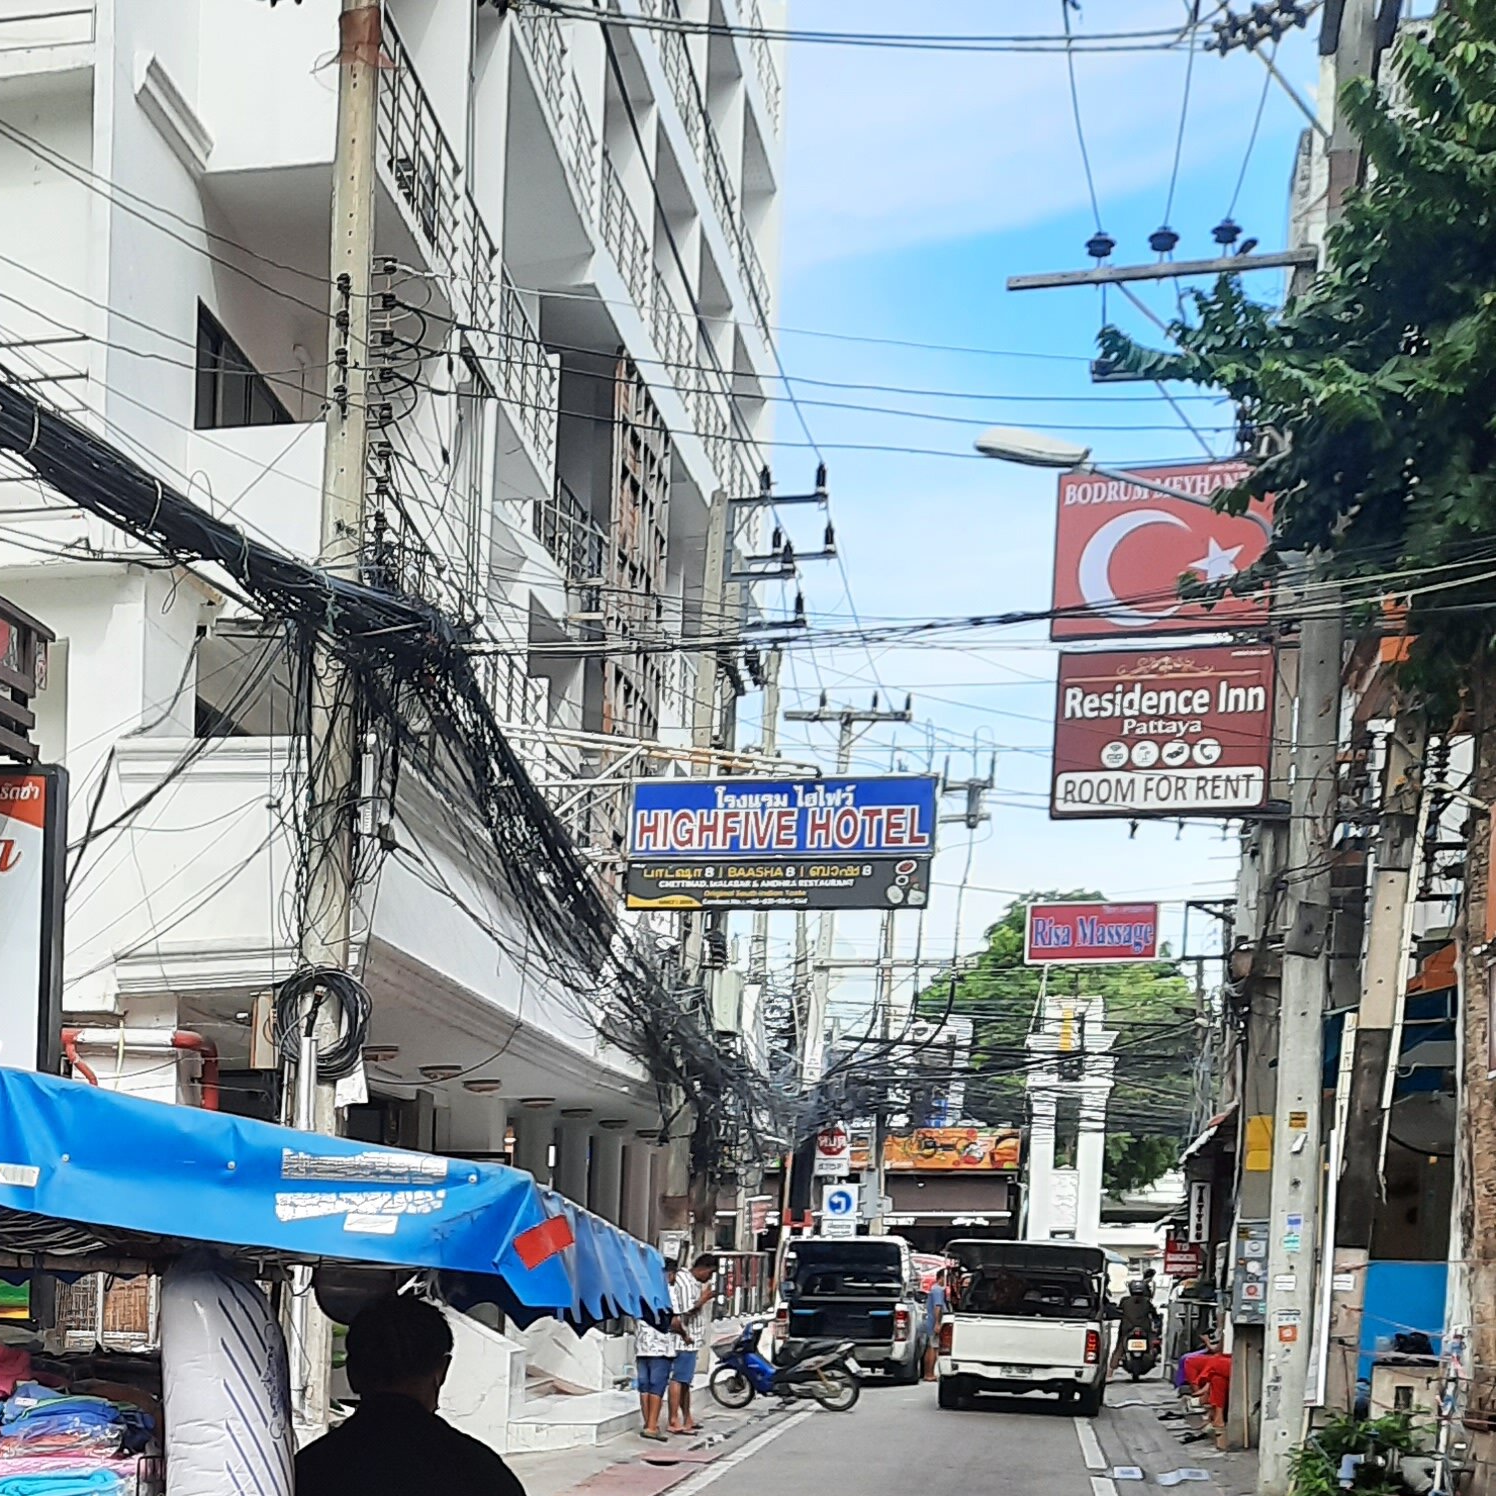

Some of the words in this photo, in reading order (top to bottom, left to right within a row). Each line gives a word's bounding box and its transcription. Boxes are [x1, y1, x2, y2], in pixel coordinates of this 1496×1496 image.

[1064, 480, 1152, 505] BODRUM
[1064, 682, 1210, 719] Residence
[1217, 680, 1266, 713] Inn
[1121, 717, 1202, 737] Pattaya
[714, 785, 788, 809] โรงแรม
[1063, 777, 1136, 804] ROOM
[1143, 775, 1188, 802] FOR
[1195, 773, 1255, 800] RENT
[637, 808, 798, 850] HIGHFIVE
[807, 805, 930, 849] HOTEL
[727, 866, 784, 878] BAASHA
[1032, 916, 1072, 948] Risa
[1076, 915, 1154, 954] Massage
[1194, 1185, 1206, 1241] TATTOO
